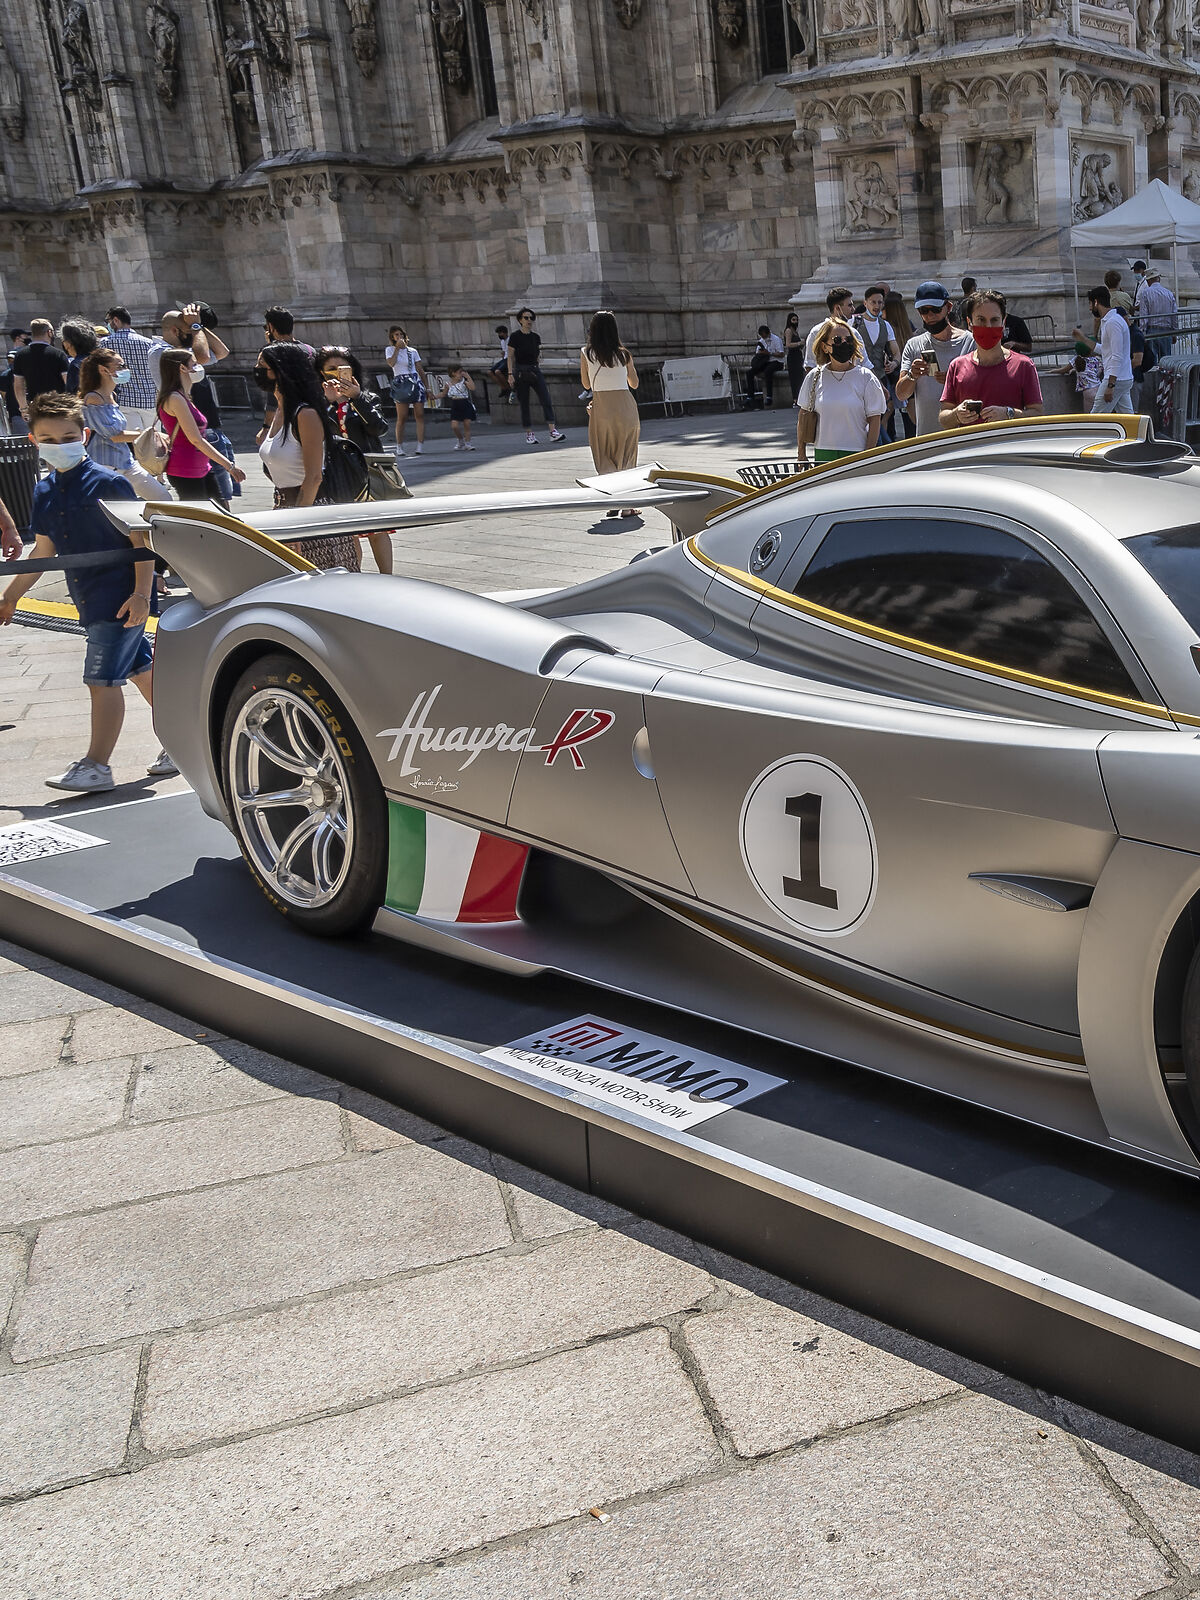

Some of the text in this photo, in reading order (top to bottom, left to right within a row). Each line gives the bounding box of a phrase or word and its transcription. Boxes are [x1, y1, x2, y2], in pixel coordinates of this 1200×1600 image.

[375, 684, 616, 777] Huayra R
[782, 792, 839, 910] 1
[506, 1048, 693, 1119] MILANO MONZA MOTOR SHOW
[588, 1041, 749, 1103] MIMO
